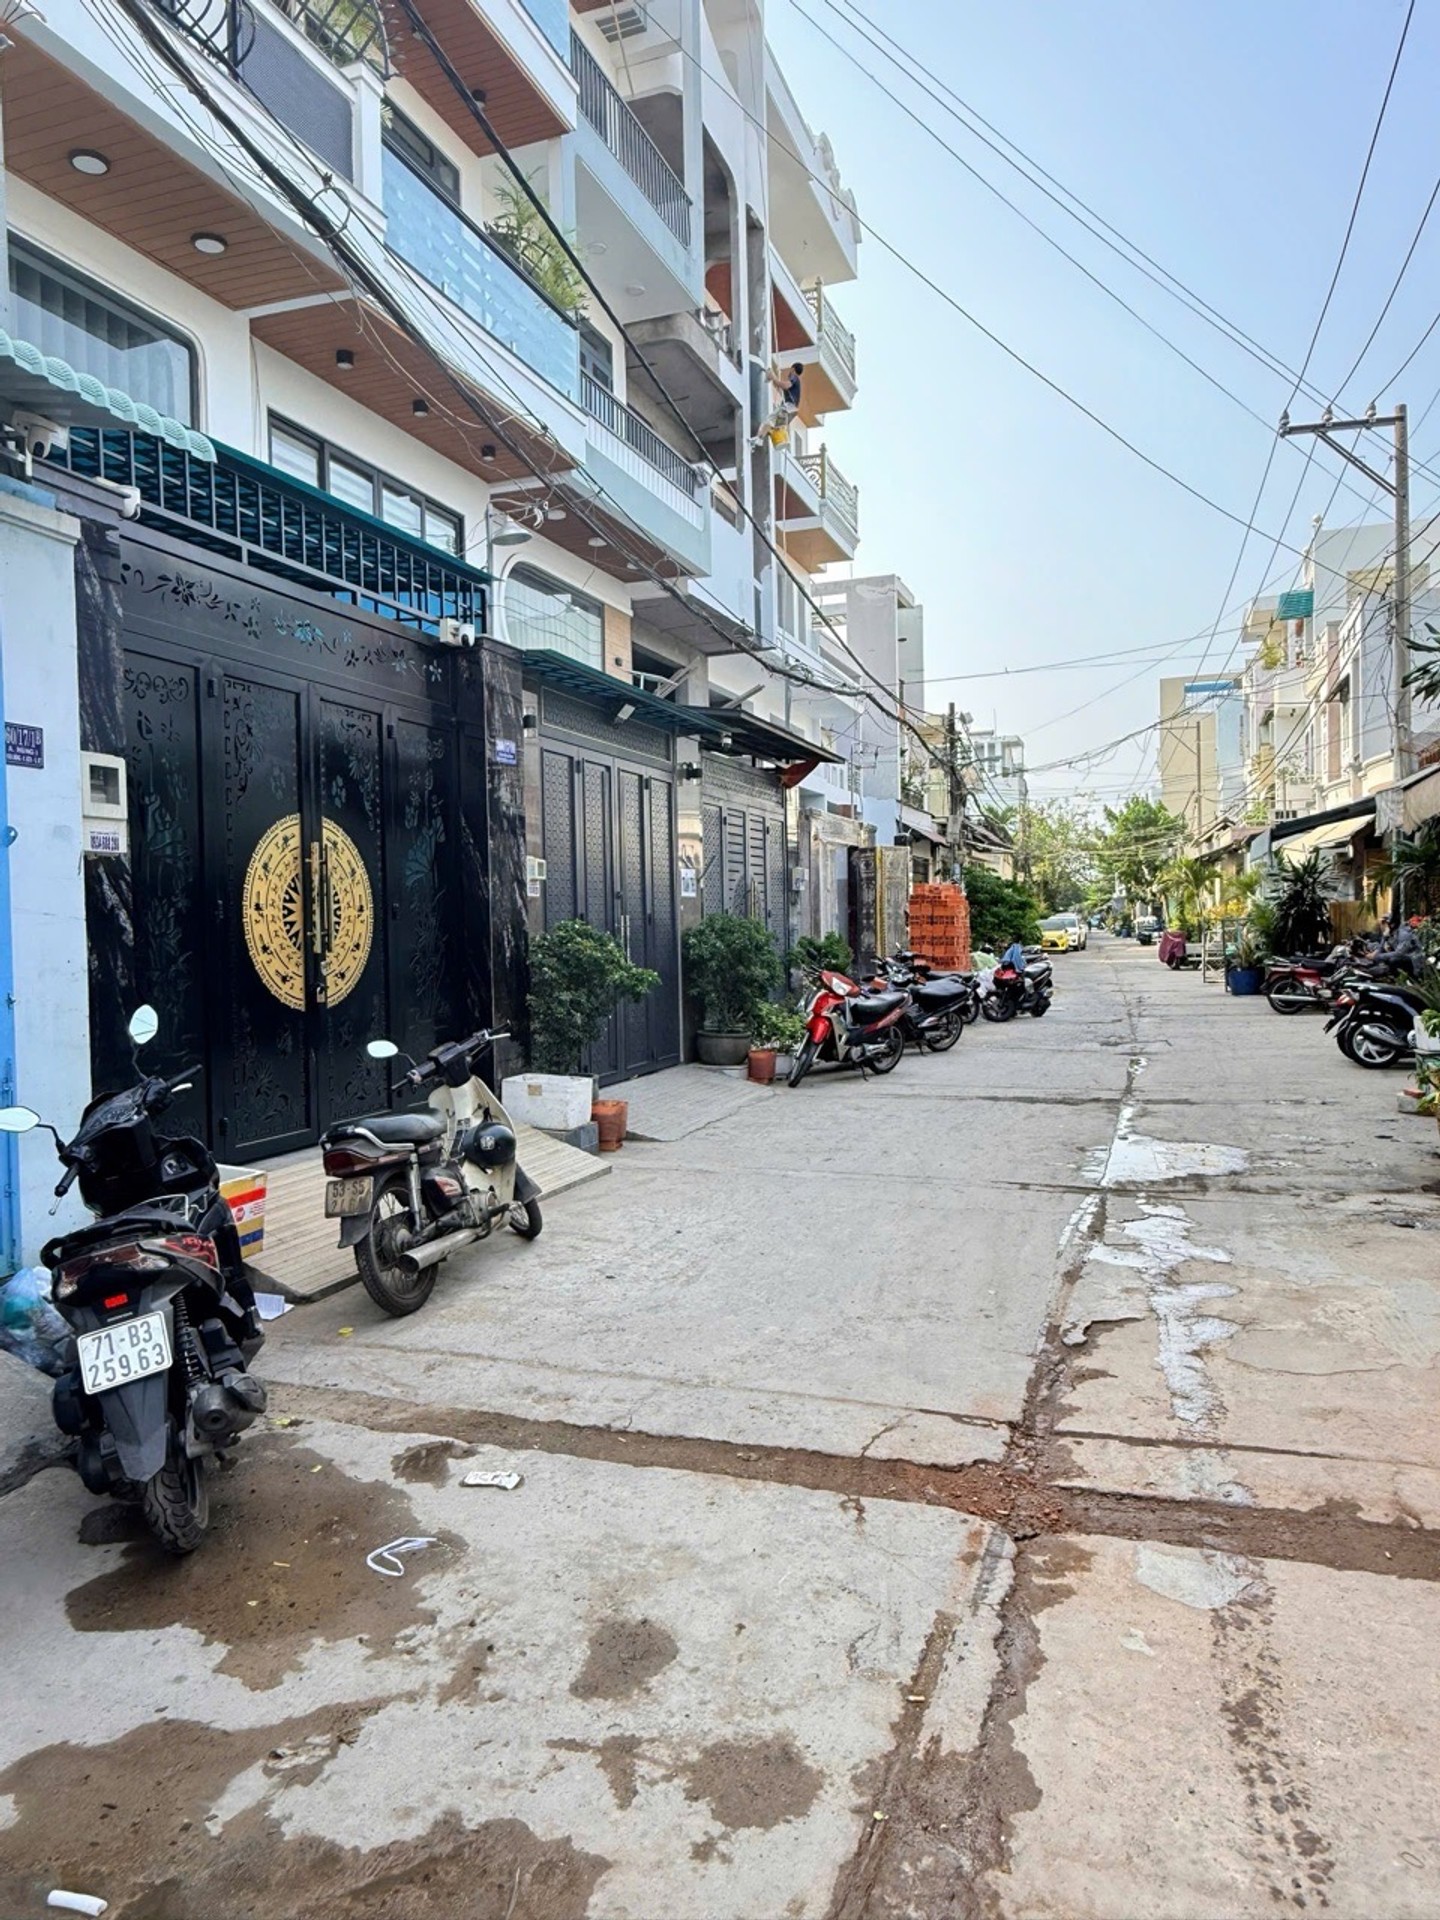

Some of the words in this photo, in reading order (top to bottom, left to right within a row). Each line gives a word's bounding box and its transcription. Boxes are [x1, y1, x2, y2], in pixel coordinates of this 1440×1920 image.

[332, 1180, 365, 1198] 53-S5
[91, 1320, 153, 1360] 71-B3
[87, 1342, 165, 1388] 259.63
